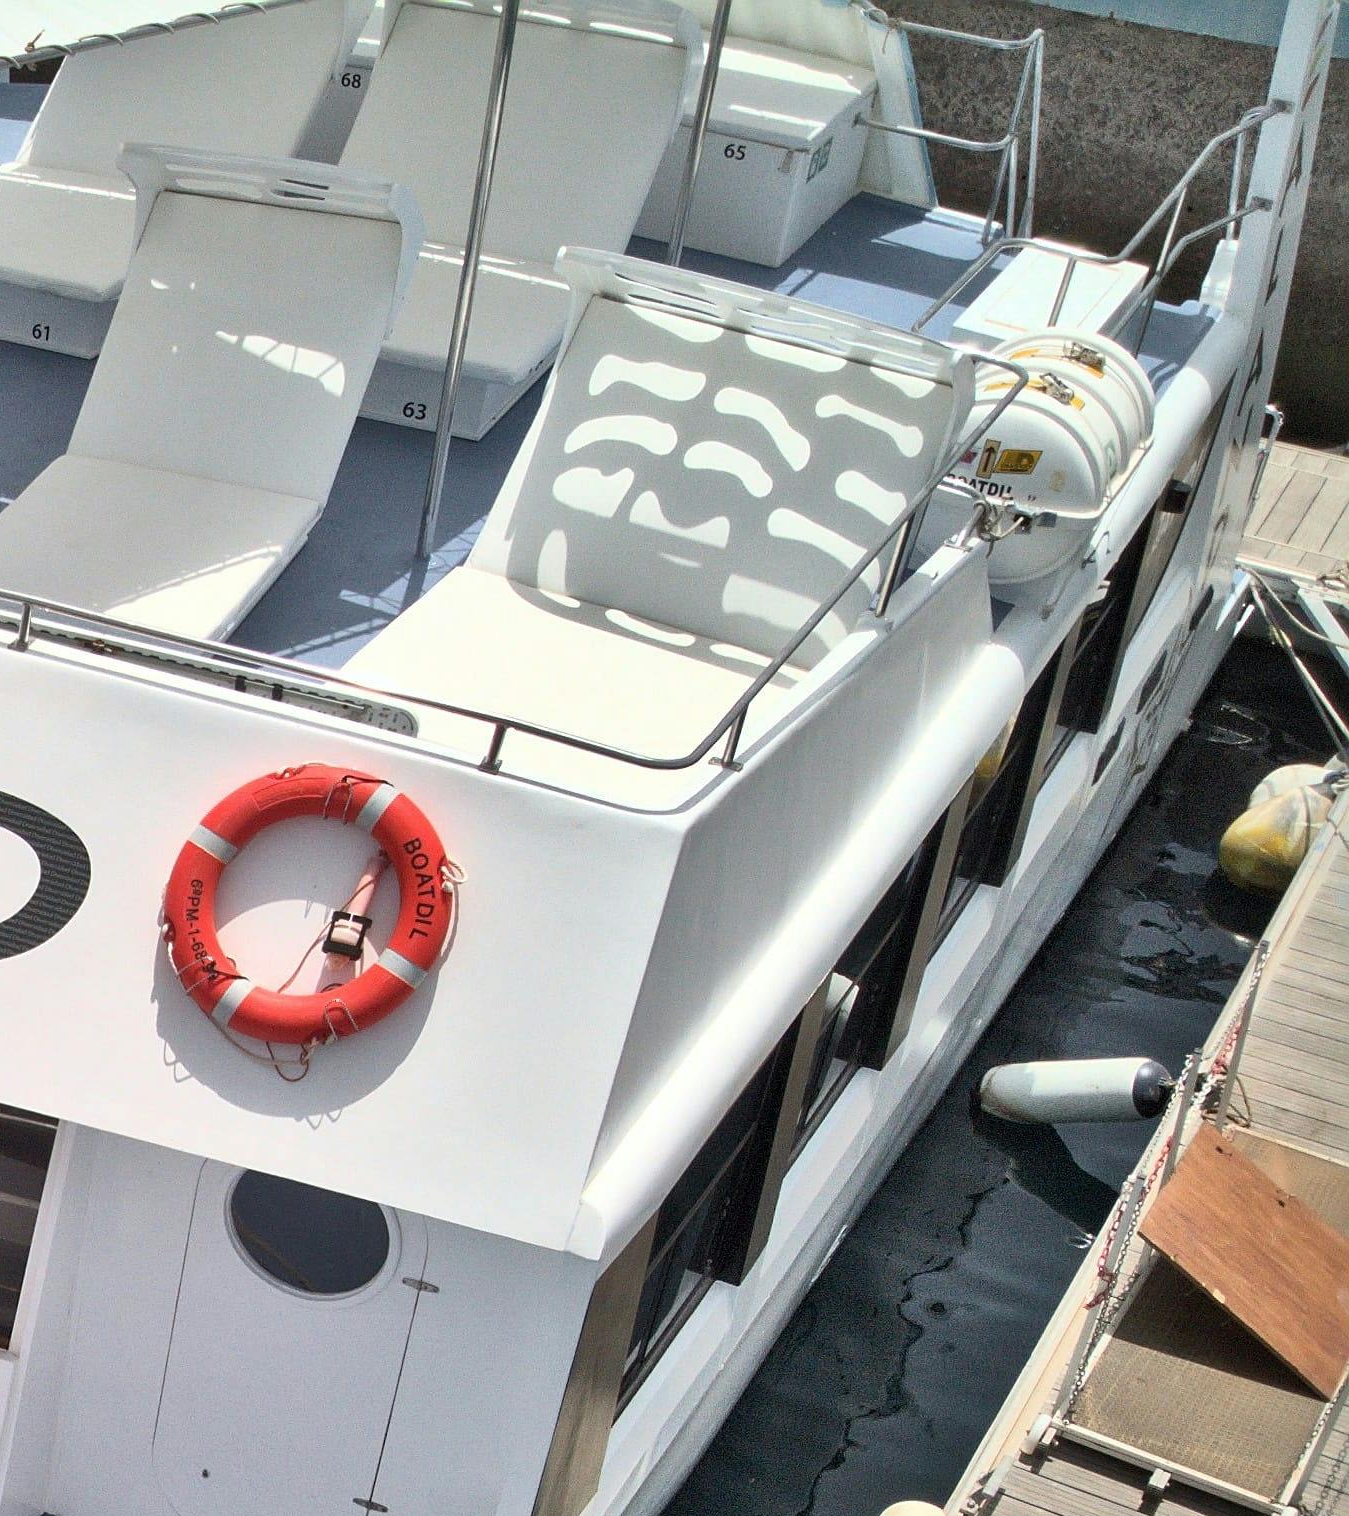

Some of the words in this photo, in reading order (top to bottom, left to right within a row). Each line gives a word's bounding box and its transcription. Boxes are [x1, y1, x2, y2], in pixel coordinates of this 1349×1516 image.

[341, 72, 361, 89] 68
[723, 143, 747, 161] 65
[32, 323, 51, 341] 61
[402, 401, 427, 420] 63
